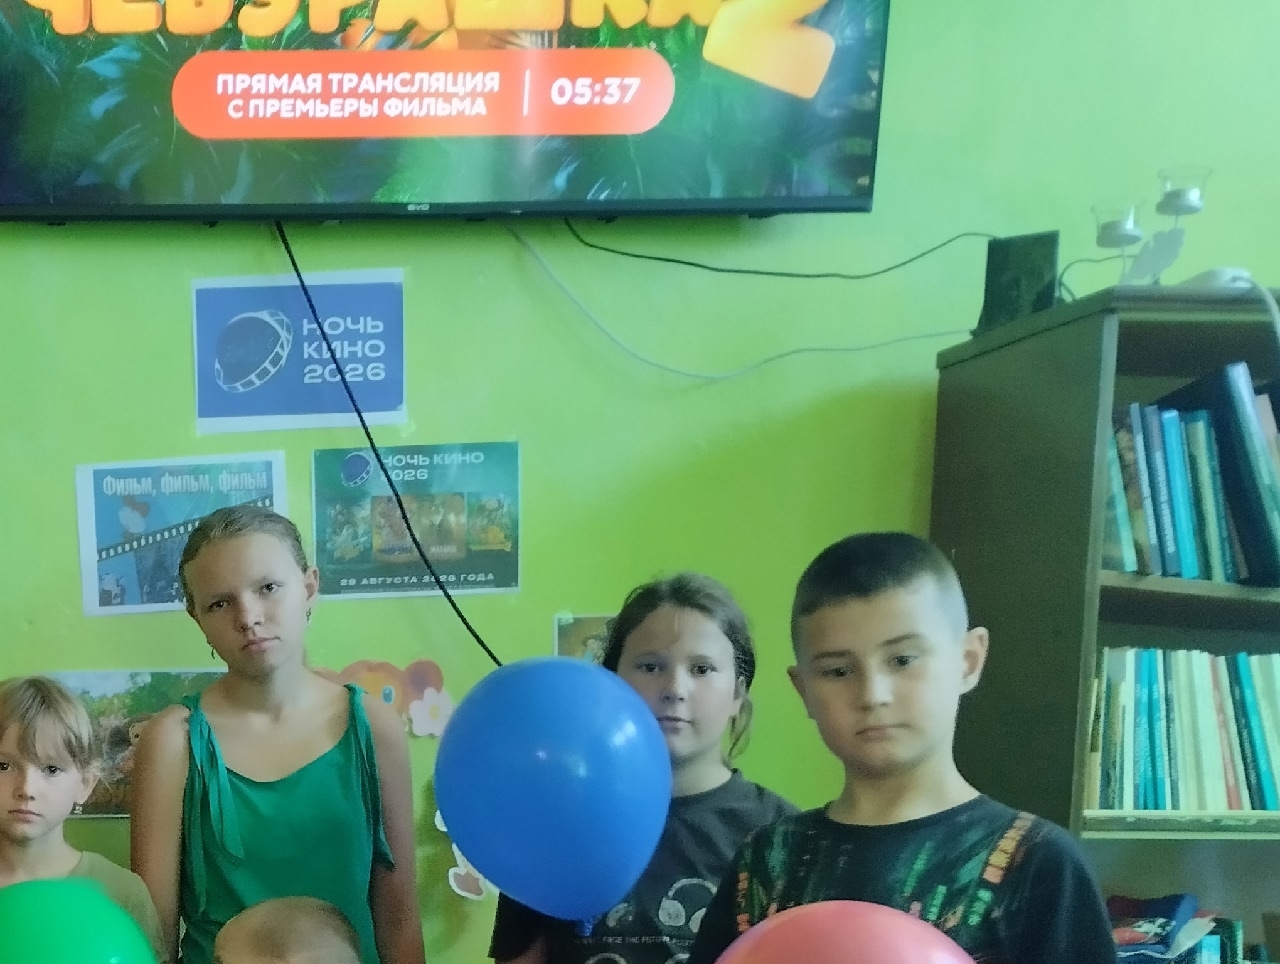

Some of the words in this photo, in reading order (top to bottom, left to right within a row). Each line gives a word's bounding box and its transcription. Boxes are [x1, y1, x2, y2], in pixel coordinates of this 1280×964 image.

[216, 72, 322, 95] ПРЯМАЯ
[328, 71, 500, 96] ТРАНСЛЯЦИЯ
[550, 77, 641, 105] 05:37
[227, 101, 244, 119] С
[248, 97, 379, 119] ПРЕМЬЕРЫ
[383, 95, 487, 118] ФИЛЬМА
[302, 316, 384, 335] НОЧЬ
[303, 339, 386, 359] КИНО
[303, 362, 386, 384] 2026
[433, 452, 485, 465] КИНО
[103, 474, 157, 497] Фильм,
[160, 472, 214, 496] фильм,
[218, 470, 268, 495] фильм
[361, 575, 418, 586] АВГУСТА
[460, 573, 495, 583] ГОДА
